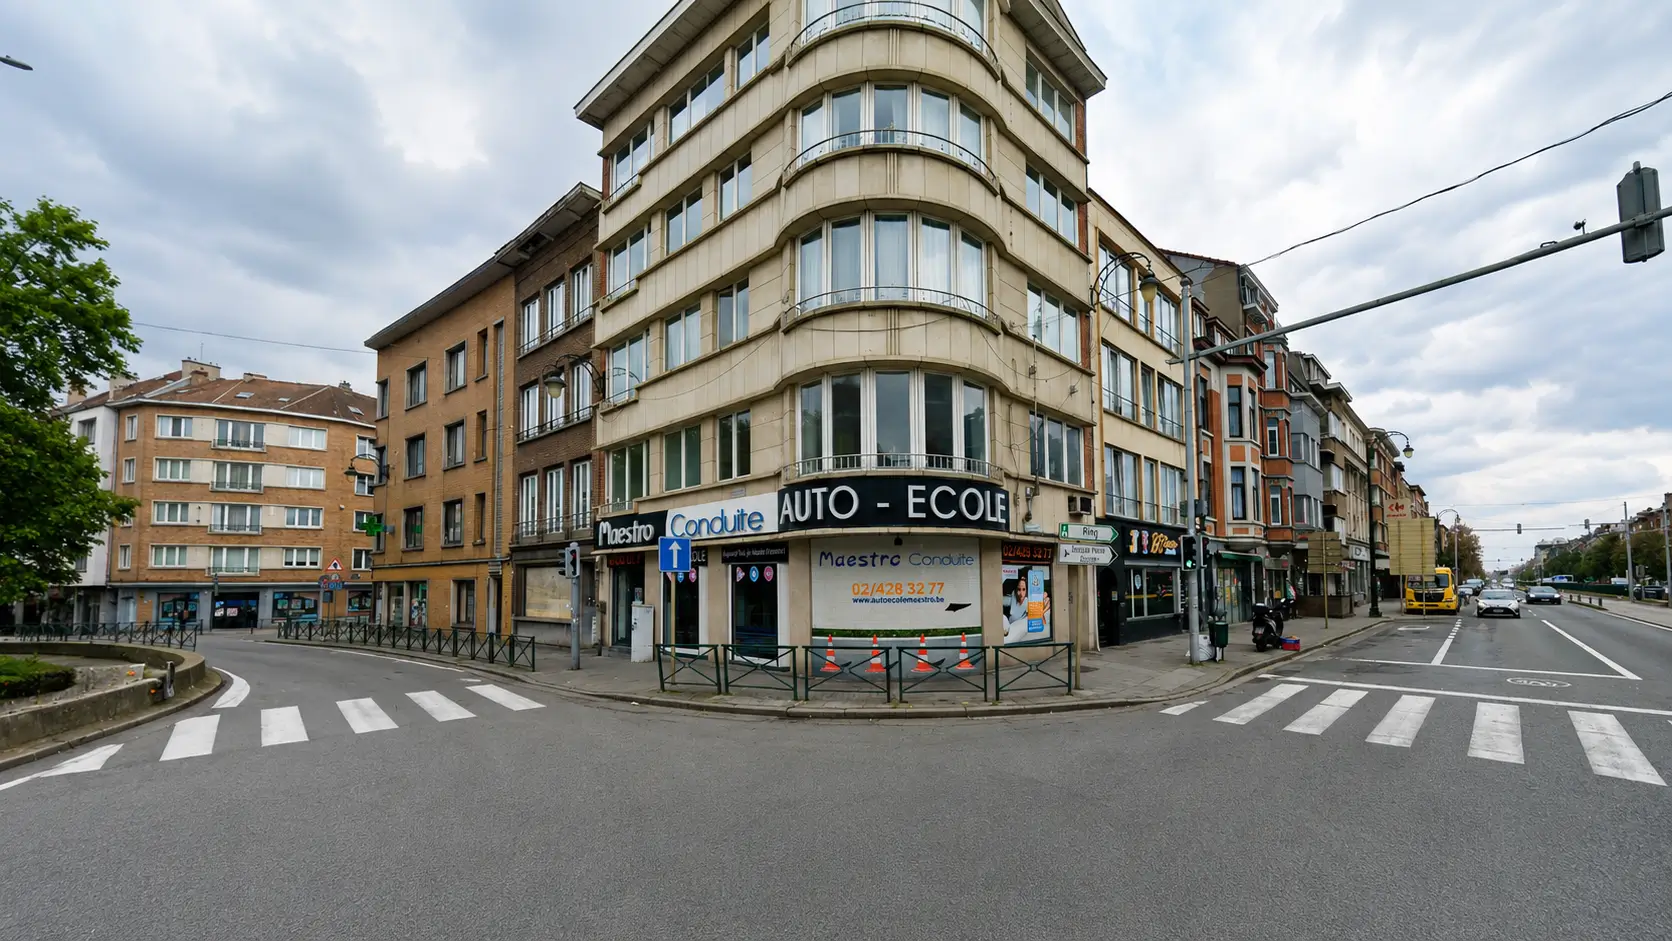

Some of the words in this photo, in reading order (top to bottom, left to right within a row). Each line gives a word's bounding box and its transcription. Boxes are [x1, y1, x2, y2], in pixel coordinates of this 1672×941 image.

[779, 485, 860, 524] AUTO
[907, 484, 1006, 524] ECOLE
[599, 520, 655, 546] Maestro
[670, 508, 764, 538] Conduite
[1082, 526, 1099, 540] Ring
[819, 551, 900, 567] Maestro
[908, 552, 975, 566] Conduite
[907, 582, 925, 595] 32
[928, 582, 945, 595] 77
